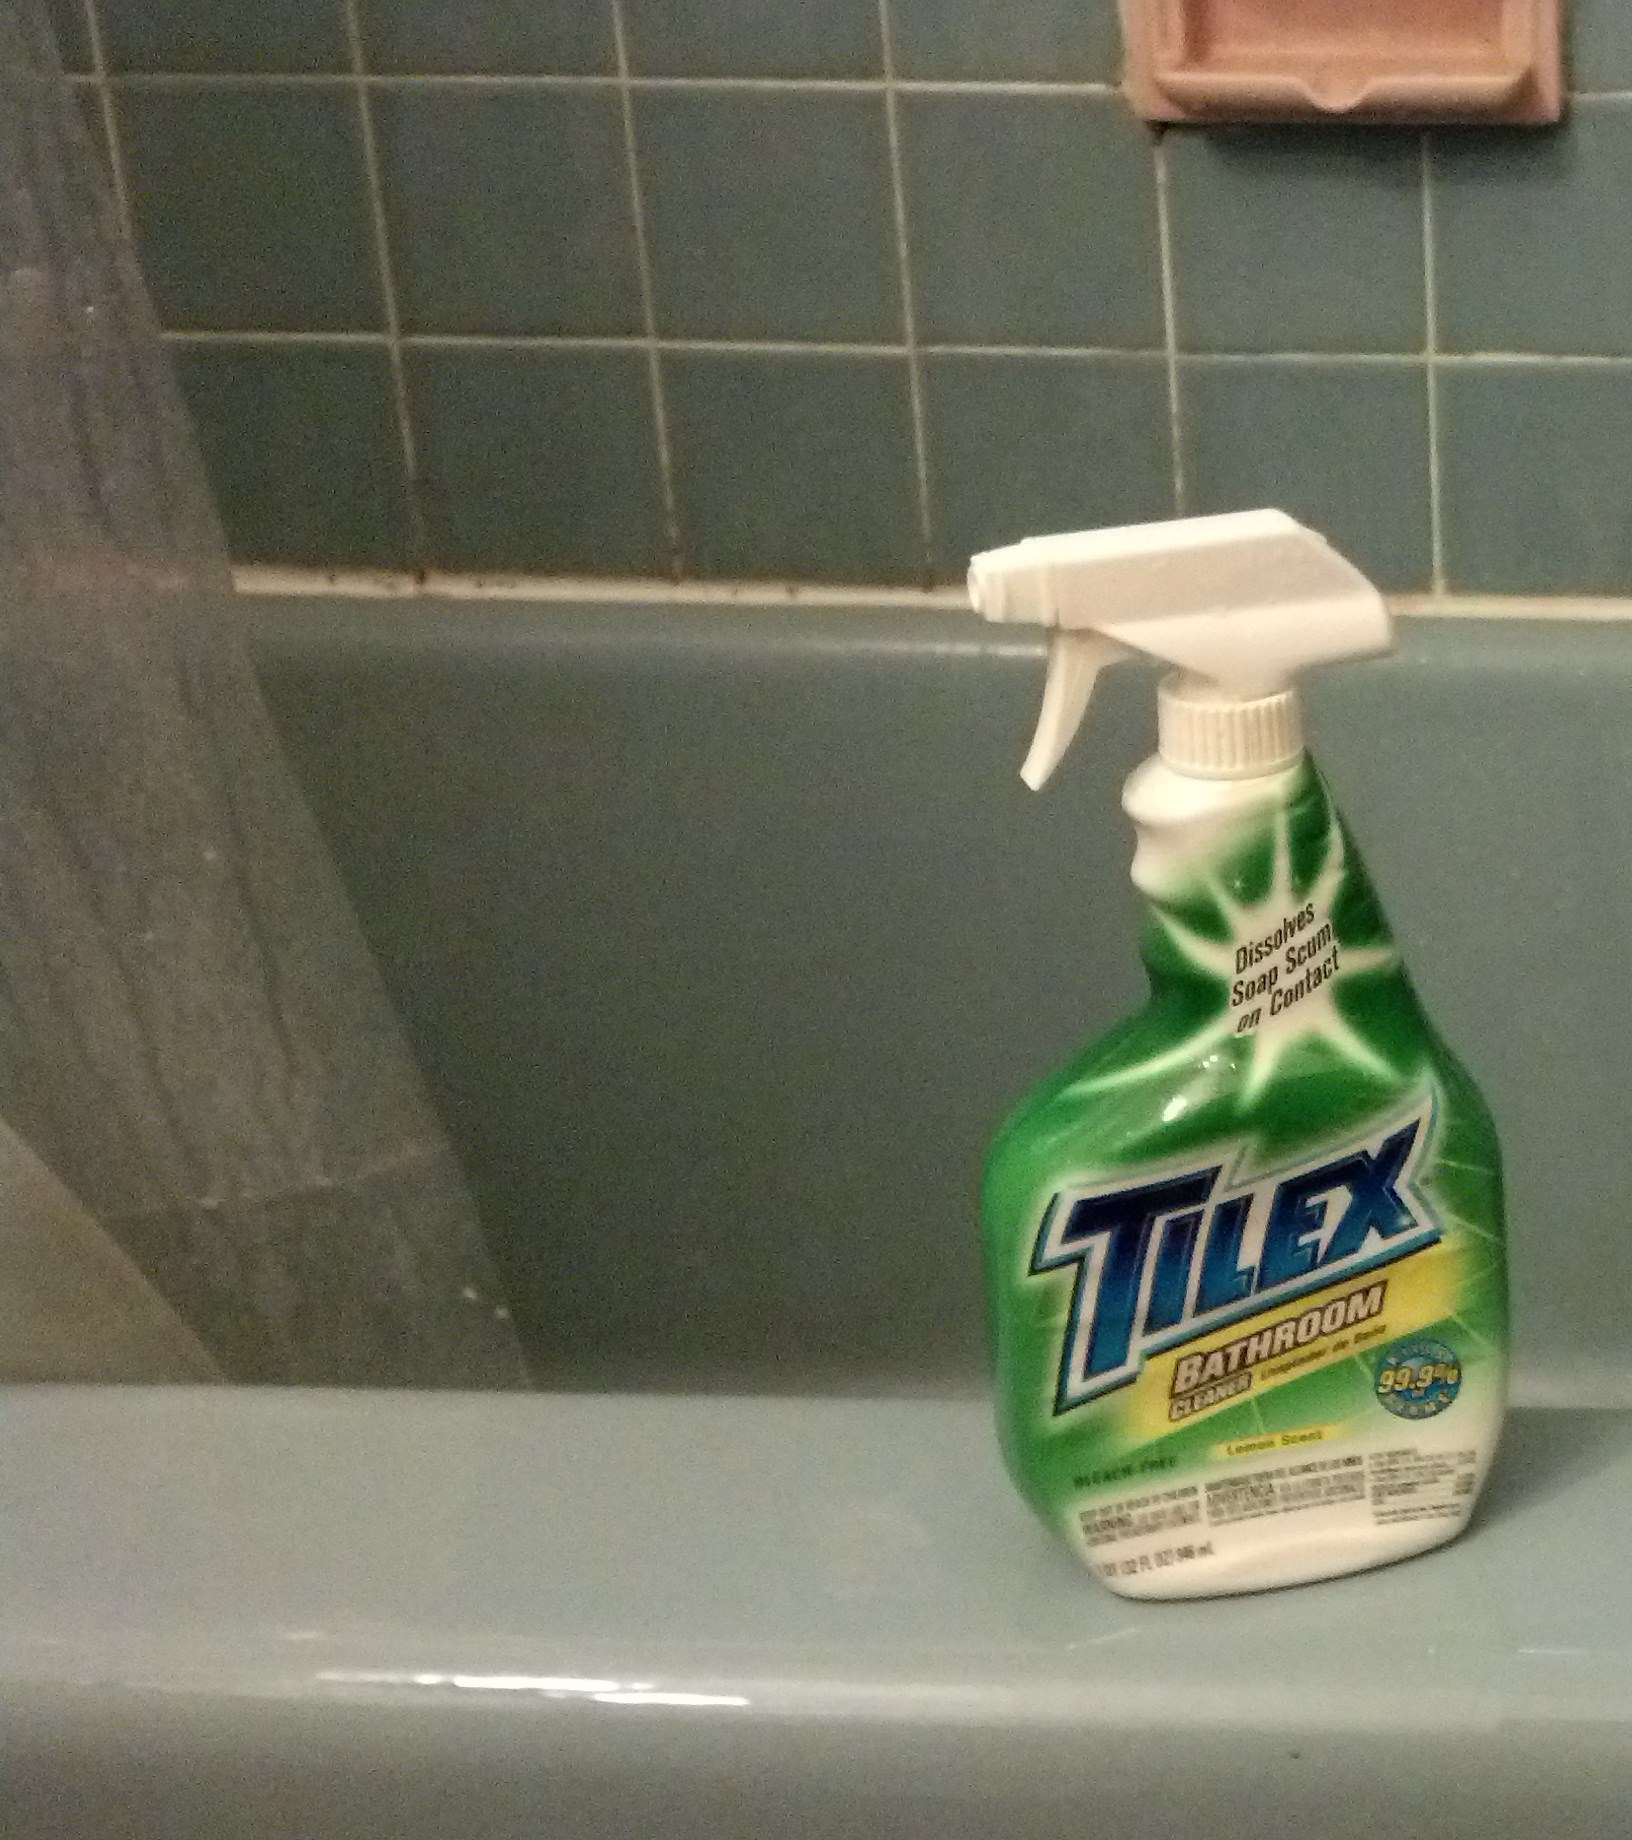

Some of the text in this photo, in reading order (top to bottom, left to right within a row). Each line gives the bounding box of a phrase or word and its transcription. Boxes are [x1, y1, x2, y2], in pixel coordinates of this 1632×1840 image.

[1231, 922, 1332, 1008] Soap Scum
[1234, 902, 1315, 975] Dissolves
[1236, 944, 1340, 1034] on Contact
[1173, 1280, 1387, 1395] BATHROOM
[1378, 1362, 1460, 1394] 99.9%
[1226, 1438, 1275, 1456] Lemon
